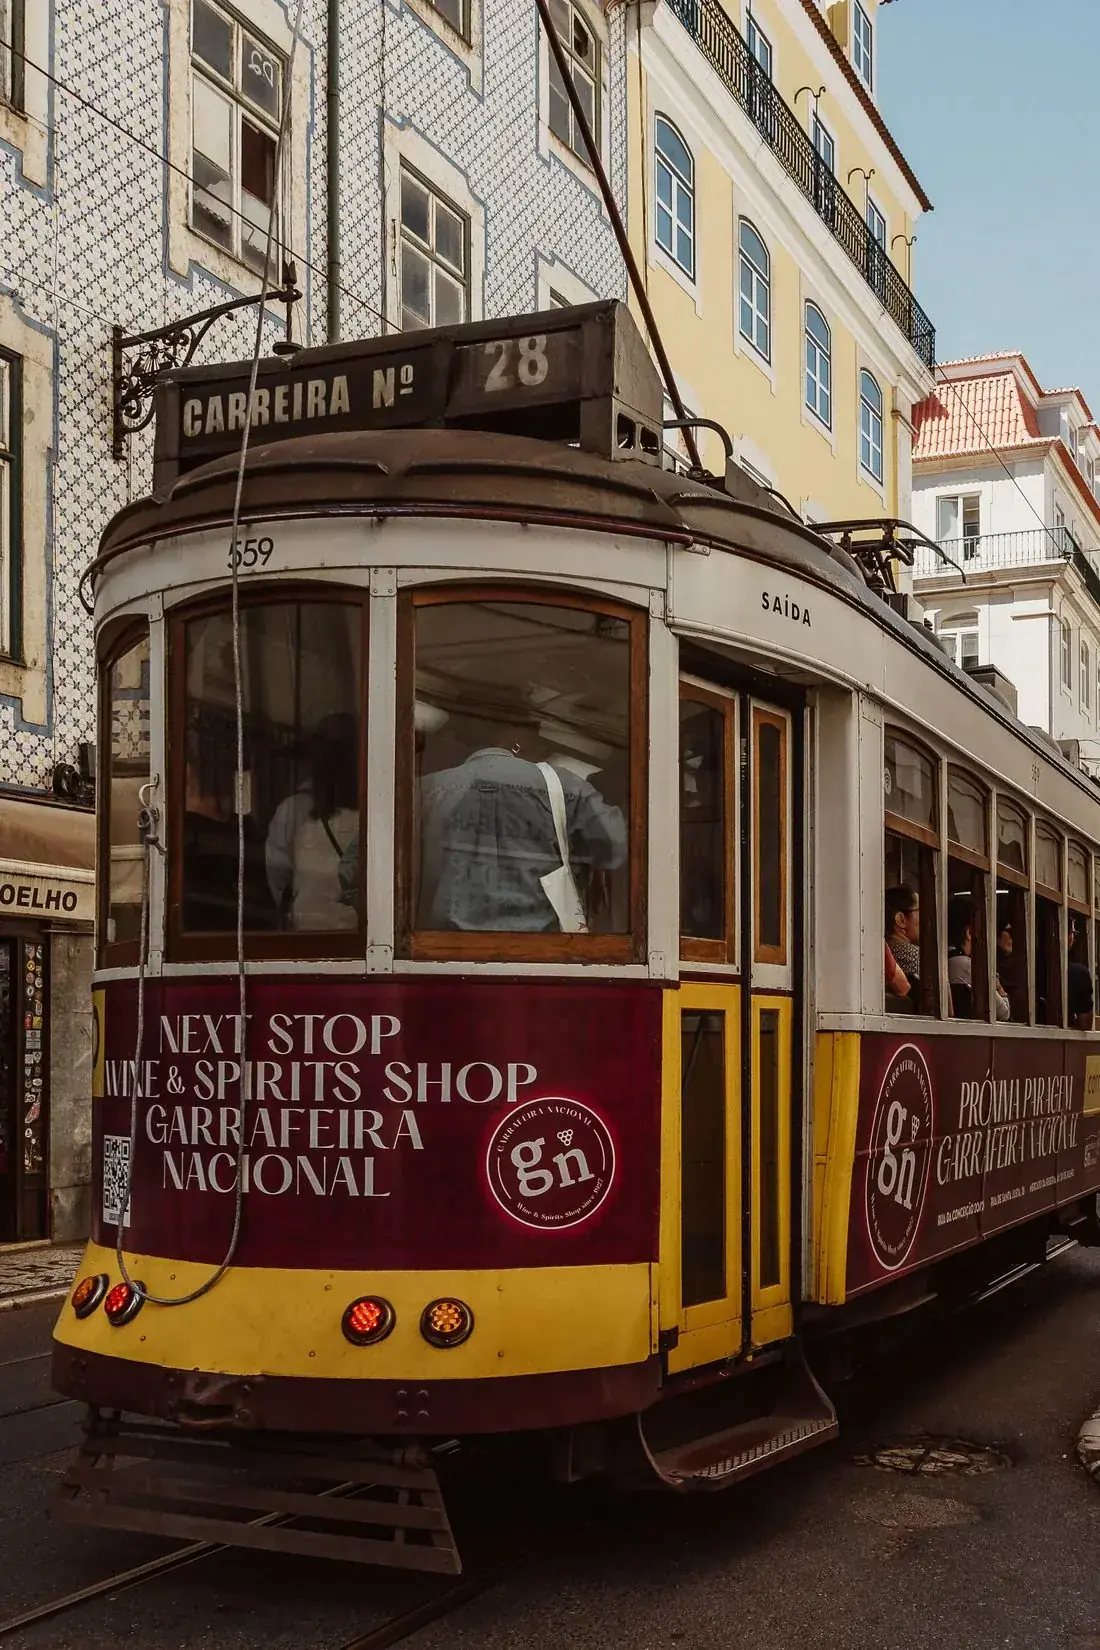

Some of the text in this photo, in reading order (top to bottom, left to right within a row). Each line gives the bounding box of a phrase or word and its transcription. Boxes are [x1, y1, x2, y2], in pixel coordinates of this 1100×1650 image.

[484, 334, 549, 392] 28
[183, 375, 350, 438] CARREIRA
[226, 537, 274, 569] 559
[761, 591, 811, 627] SAÍDA
[0, 884, 78, 911] OELHO
[159, 1013, 401, 1055] NEXT STOP
[105, 1059, 538, 1103] WINE & SPIRITS SHOP
[145, 1104, 425, 1150] GARRAFEIRA
[163, 1151, 391, 1197] NACIONAL
[510, 1137, 595, 1197] gn
[877, 1100, 912, 1210] gn
[936, 1122, 1026, 1186] GARRAFEIRA
